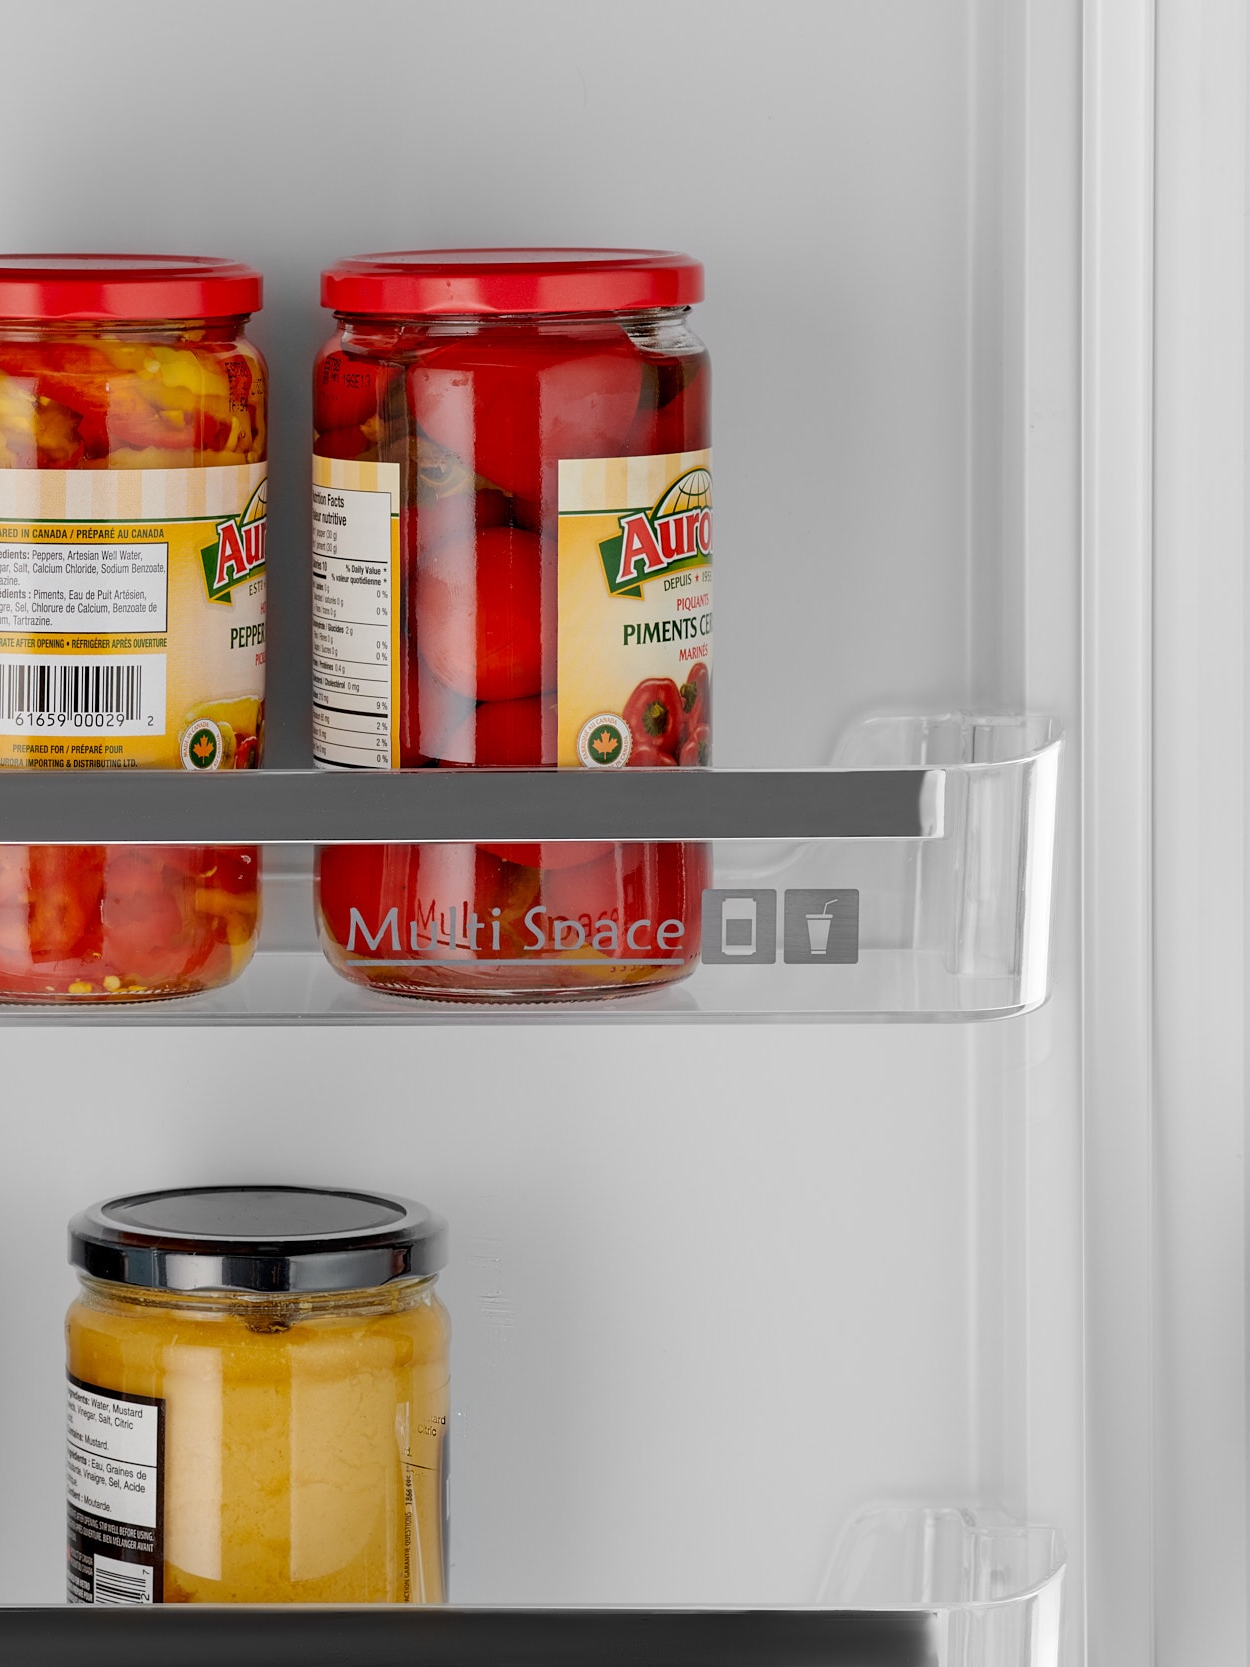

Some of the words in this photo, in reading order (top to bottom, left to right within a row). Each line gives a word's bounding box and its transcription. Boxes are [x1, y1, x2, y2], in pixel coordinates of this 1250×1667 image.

[327, 493, 345, 508] Facts
[322, 511, 347, 526] nutritive
[21, 528, 30, 538] IN
[32, 529, 68, 539] CANADA
[76, 527, 115, 539] PRÉPARÉ
[117, 528, 129, 539] AU
[131, 528, 165, 539] CANADA
[32, 550, 65, 562] Peppers,
[67, 550, 100, 561] Artesian
[101, 550, 117, 561] Well
[119, 550, 143, 562] Water,
[13, 562, 30, 574] Salt,
[32, 563, 63, 574] Calcium
[65, 563, 99, 575] Chloride,
[101, 563, 129, 574] Sodium
[131, 562, 166, 574] Benzoate,
[351, 564, 364, 575] Daily
[365, 565, 381, 575] Value
[336, 574, 349, 583] valeur
[350, 576, 382, 587] quotidienne
[663, 573, 692, 591] DEPUIS
[33, 589, 66, 602] Piments,
[68, 590, 83, 600] Eau
[85, 590, 95, 600] de
[97, 589, 112, 600] Puit
[114, 589, 147, 601] Artésien,
[676, 593, 709, 611] PIQUANTS
[14, 602, 29, 614] Sel,
[31, 602, 64, 613] Chlorure
[65, 602, 75, 613] de
[77, 602, 111, 614] Calcium,
[112, 602, 147, 613] Benzoate
[148, 602, 157, 613] de
[13, 615, 52, 626] Tartrazine.
[623, 617, 697, 645] PIMENTS
[16, 637, 36, 648] AFTER
[37, 638, 65, 649] OPENING
[71, 638, 110, 649] RÉFRIGÉRER
[111, 636, 132, 648] APRÈS
[133, 637, 167, 648] OUVERTURE
[679, 643, 709, 662] MARINÉS
[15, 713, 66, 727] 61659
[74, 713, 125, 727] 00029
[147, 716, 155, 727] 2
[12, 744, 49, 754] PREPARED
[50, 745, 65, 754] FOR
[71, 743, 103, 755] PRÉPARÉ
[104, 745, 123, 755] POUR
[25, 758, 65, 768] IMPORTING
[65, 759, 72, 768] &
[73, 759, 121, 768] DISTRIBUTING
[123, 758, 138, 768] LTD.
[346, 906, 501, 951] Multi
[523, 905, 685, 951] Space
[91, 1397, 110, 1412] Water,
[112, 1403, 143, 1419] Mustard
[77, 1406, 97, 1422] Vinegar,
[98, 1413, 113, 1427] Salt,
[114, 1417, 134, 1430] Citric
[84, 1432, 109, 1450] Mustard.
[91, 1458, 105, 1472] Eau,
[106, 1463, 134, 1478] Graines
[136, 1470, 147, 1481] de
[83, 1468, 107, 1486] Vinaigre,
[109, 1477, 122, 1490] Sel,
[123, 1480, 146, 1493] Acide
[84, 1495, 112, 1512] Moutarde.
[405, 1488, 413, 1506] 1866
[99, 1521, 108, 1532] STIR
[108, 1524, 119, 1535] WELL
[119, 1526, 137, 1539] BEFORE
[137, 1530, 155, 1542] USING.
[404, 1512, 412, 1546] QUESTIONS
[103, 1533, 112, 1544] BIEN
[113, 1536, 137, 1550] MÉLANGER
[137, 1543, 154, 1553] AVANT
